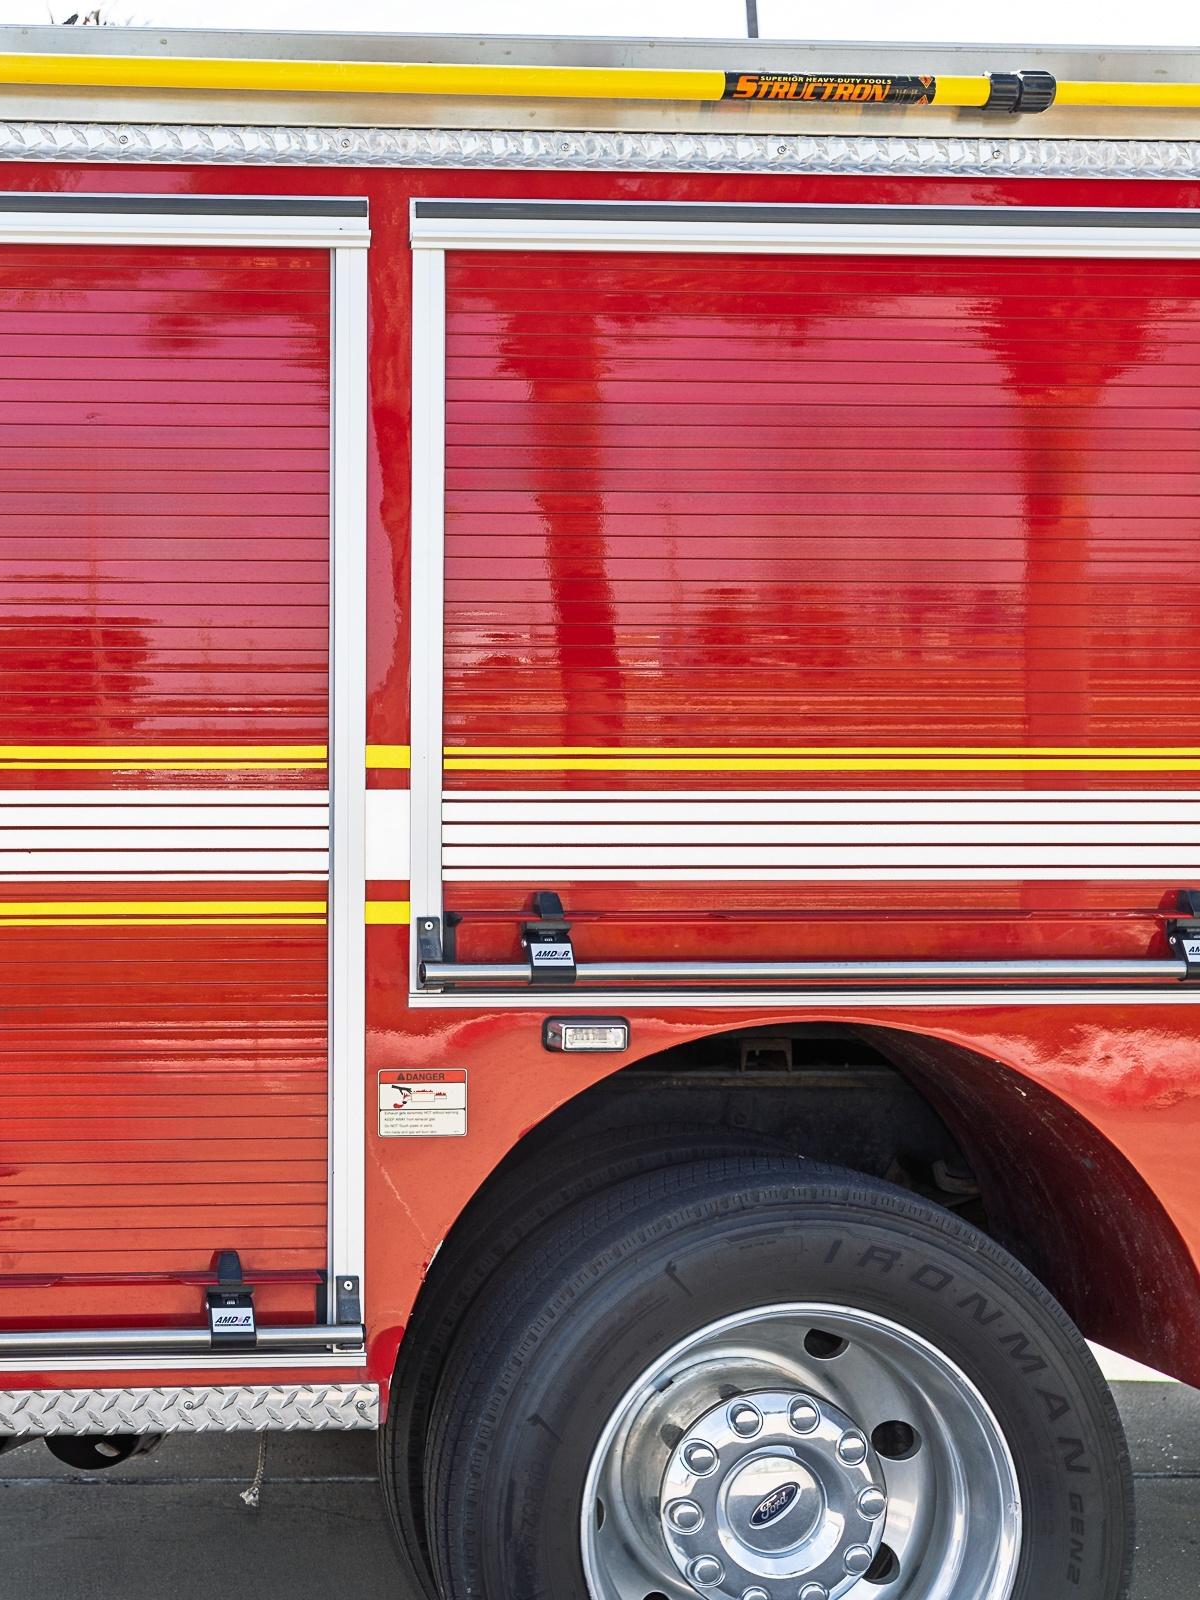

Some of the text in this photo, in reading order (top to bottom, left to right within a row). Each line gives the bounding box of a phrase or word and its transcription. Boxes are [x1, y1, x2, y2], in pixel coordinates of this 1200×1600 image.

[732, 75, 891, 102] STRUCTRON
[806, 76, 863, 84] HEAVY-DUTY
[406, 1072, 445, 1081] DANGER
[215, 1316, 251, 1324] AMDR
[823, 1239, 1091, 1475] IRONMAN
[760, 1491, 789, 1519] Ford
